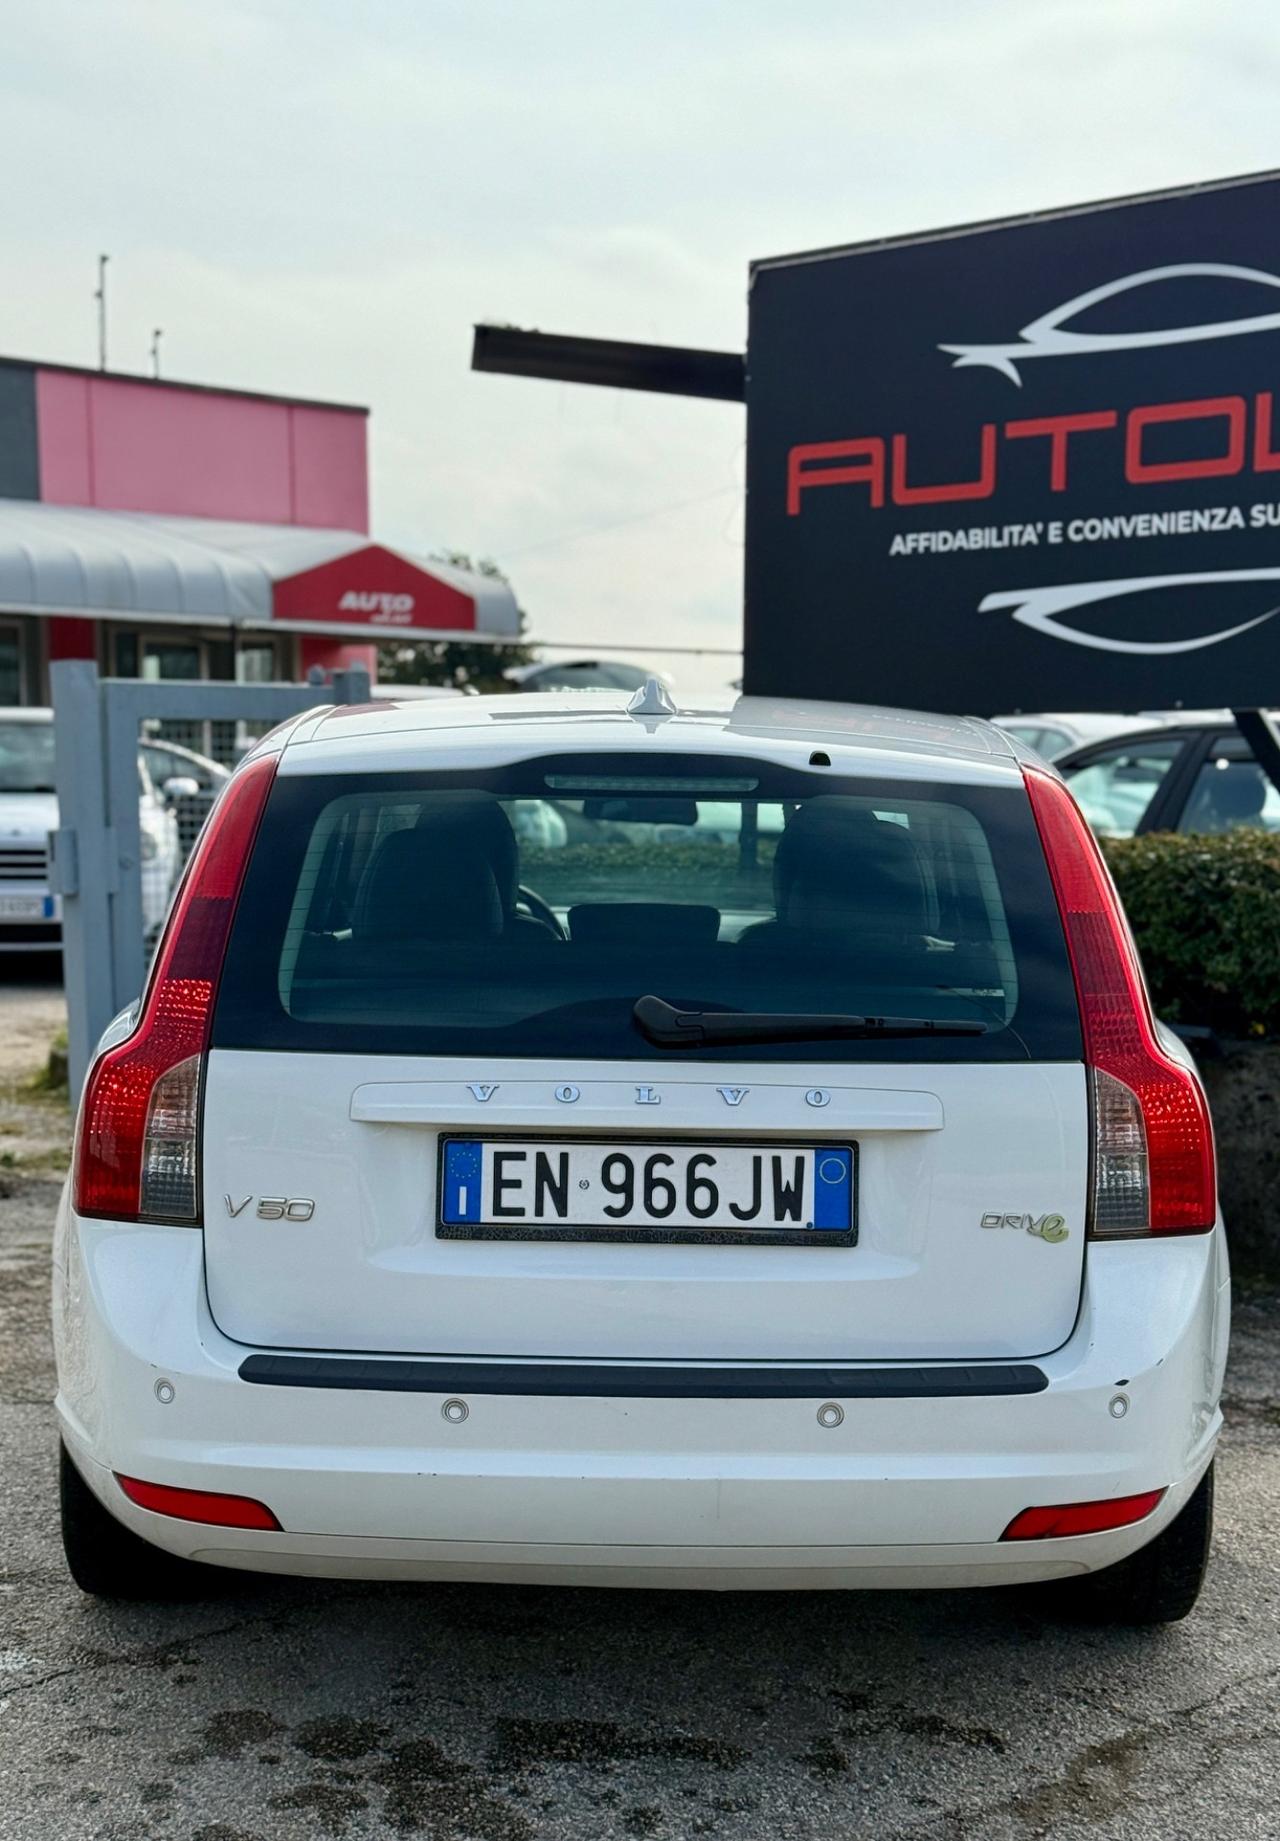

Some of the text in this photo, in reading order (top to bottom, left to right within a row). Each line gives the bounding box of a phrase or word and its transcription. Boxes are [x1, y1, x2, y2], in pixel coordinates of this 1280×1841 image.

[889, 523, 1043, 556] AFFIDABILITA'
[1048, 521, 1063, 543] E
[1067, 506, 1245, 542] CONVENIENZA
[338, 590, 414, 612] AUTO
[467, 1084, 831, 1107] VOLVO
[492, 1151, 806, 1222] EN 966JW
